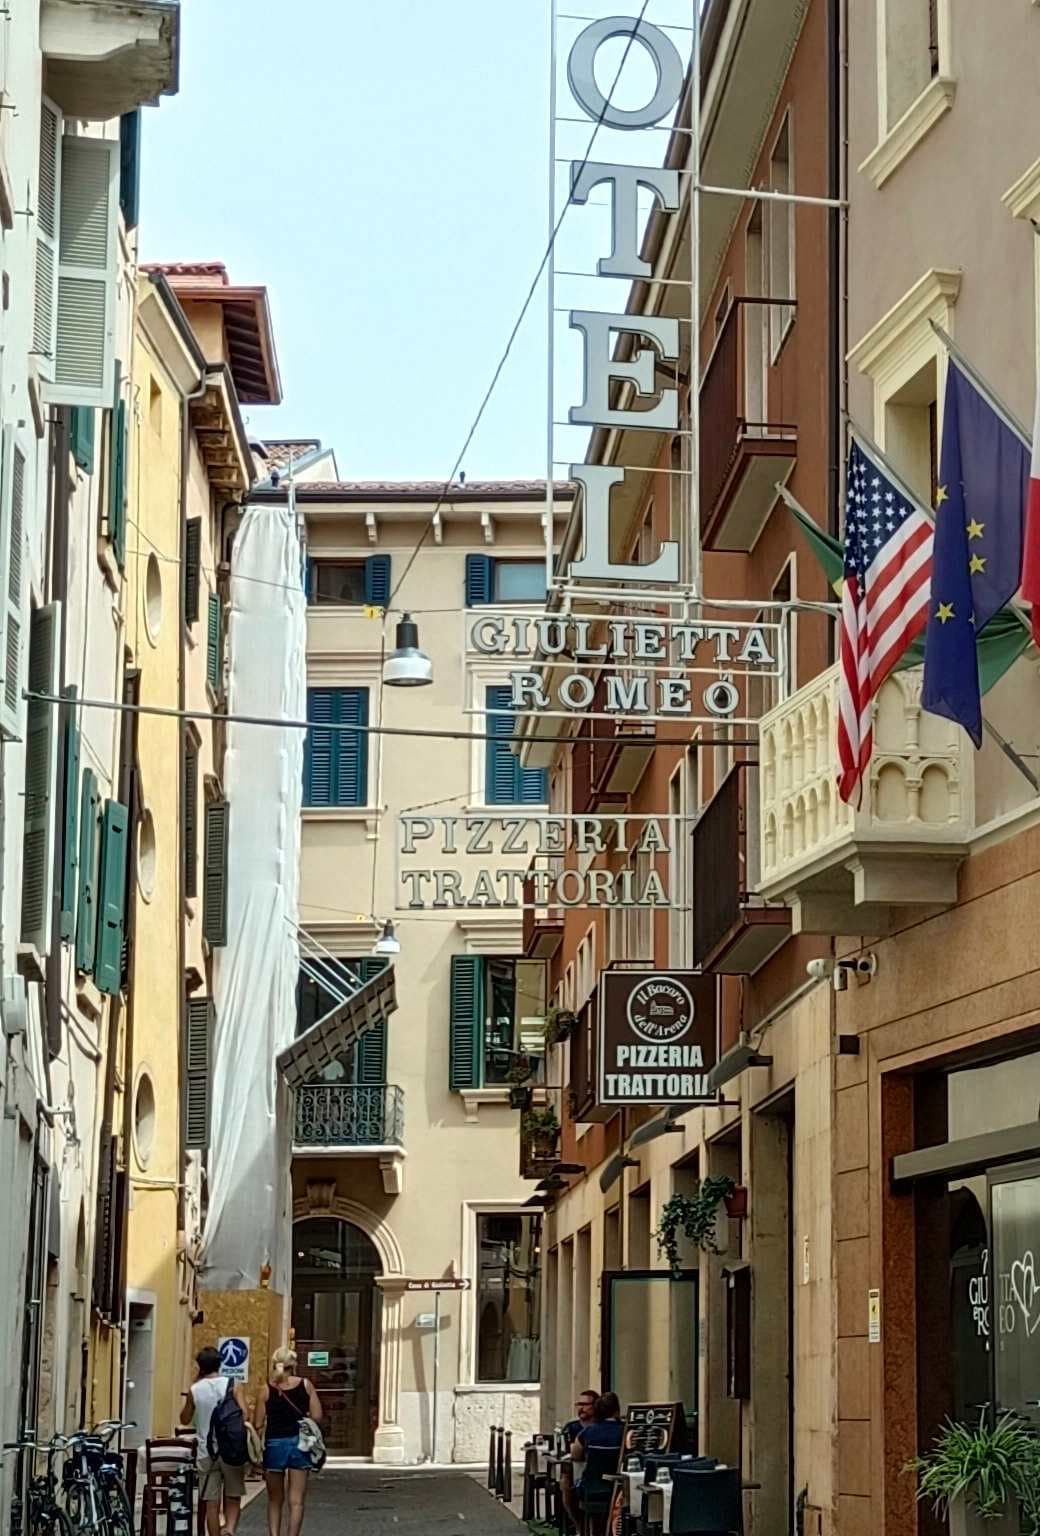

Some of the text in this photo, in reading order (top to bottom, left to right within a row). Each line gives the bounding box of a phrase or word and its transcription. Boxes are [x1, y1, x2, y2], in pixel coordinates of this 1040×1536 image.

[470, 616, 776, 665] GIULIETTA
[509, 670, 740, 715] ROMEO
[400, 817, 672, 854] PIZZERIA
[401, 868, 671, 906] TRATTORIA
[646, 983, 687, 1005] Bacaro
[634, 1014, 688, 1037] dell'Arena
[616, 1044, 704, 1068] PIZZERIA
